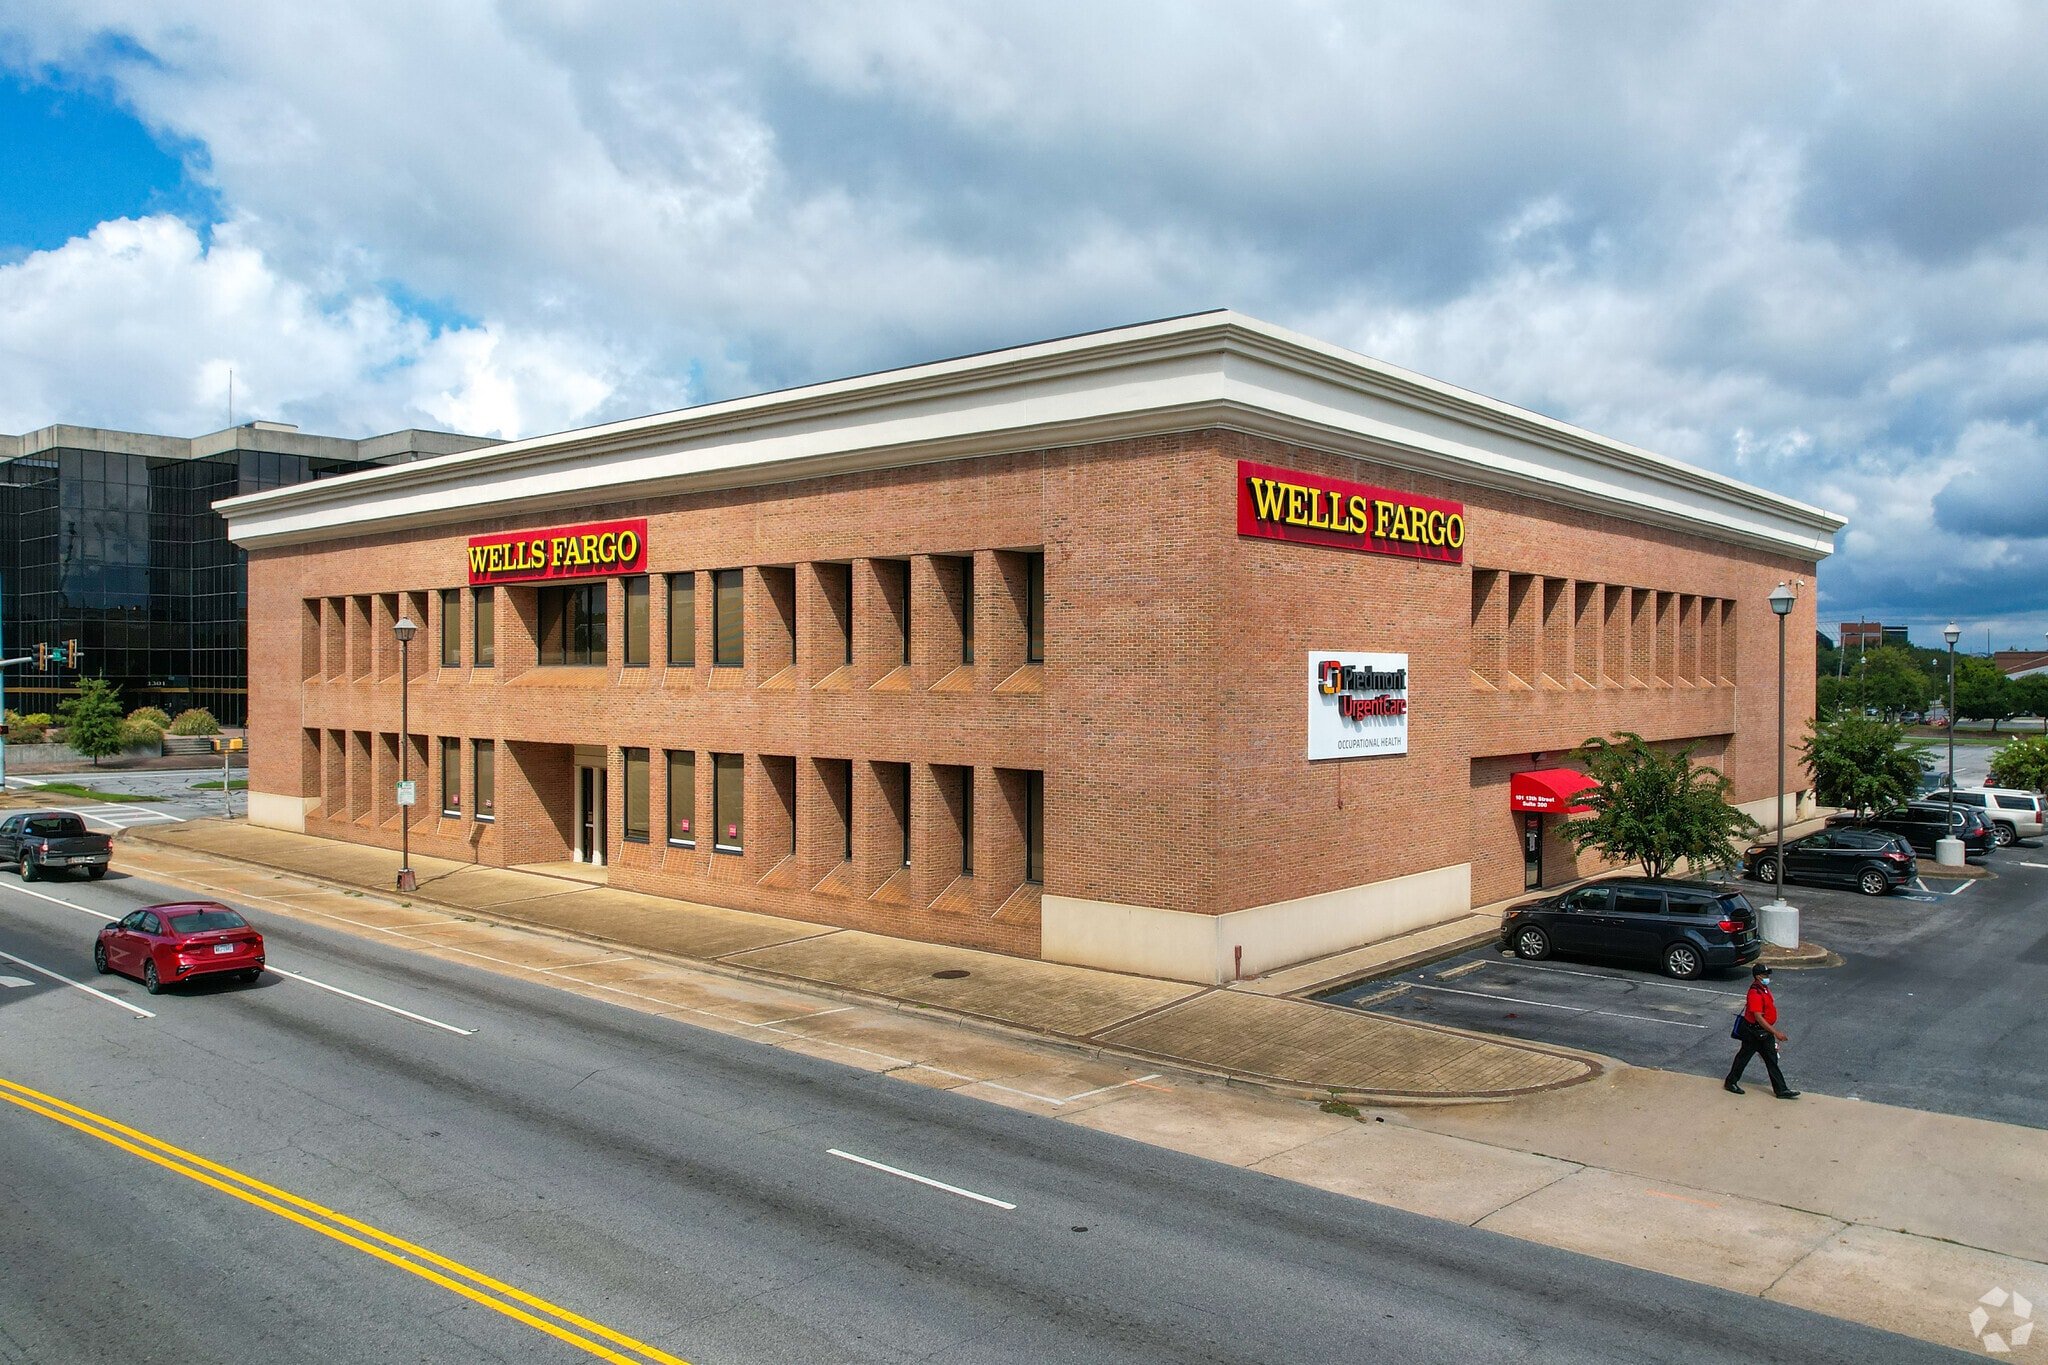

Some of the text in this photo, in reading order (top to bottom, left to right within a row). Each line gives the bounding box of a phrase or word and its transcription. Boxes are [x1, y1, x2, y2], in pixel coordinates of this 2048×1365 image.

[1248, 476, 1465, 549] WELLS FARGO
[467, 530, 638, 573] WELLS FARGO
[1342, 665, 1406, 690] Piedmont
[1339, 694, 1406, 721] UrgentCare
[1337, 737, 1401, 749] OCCUPATIONAL HEALTH
